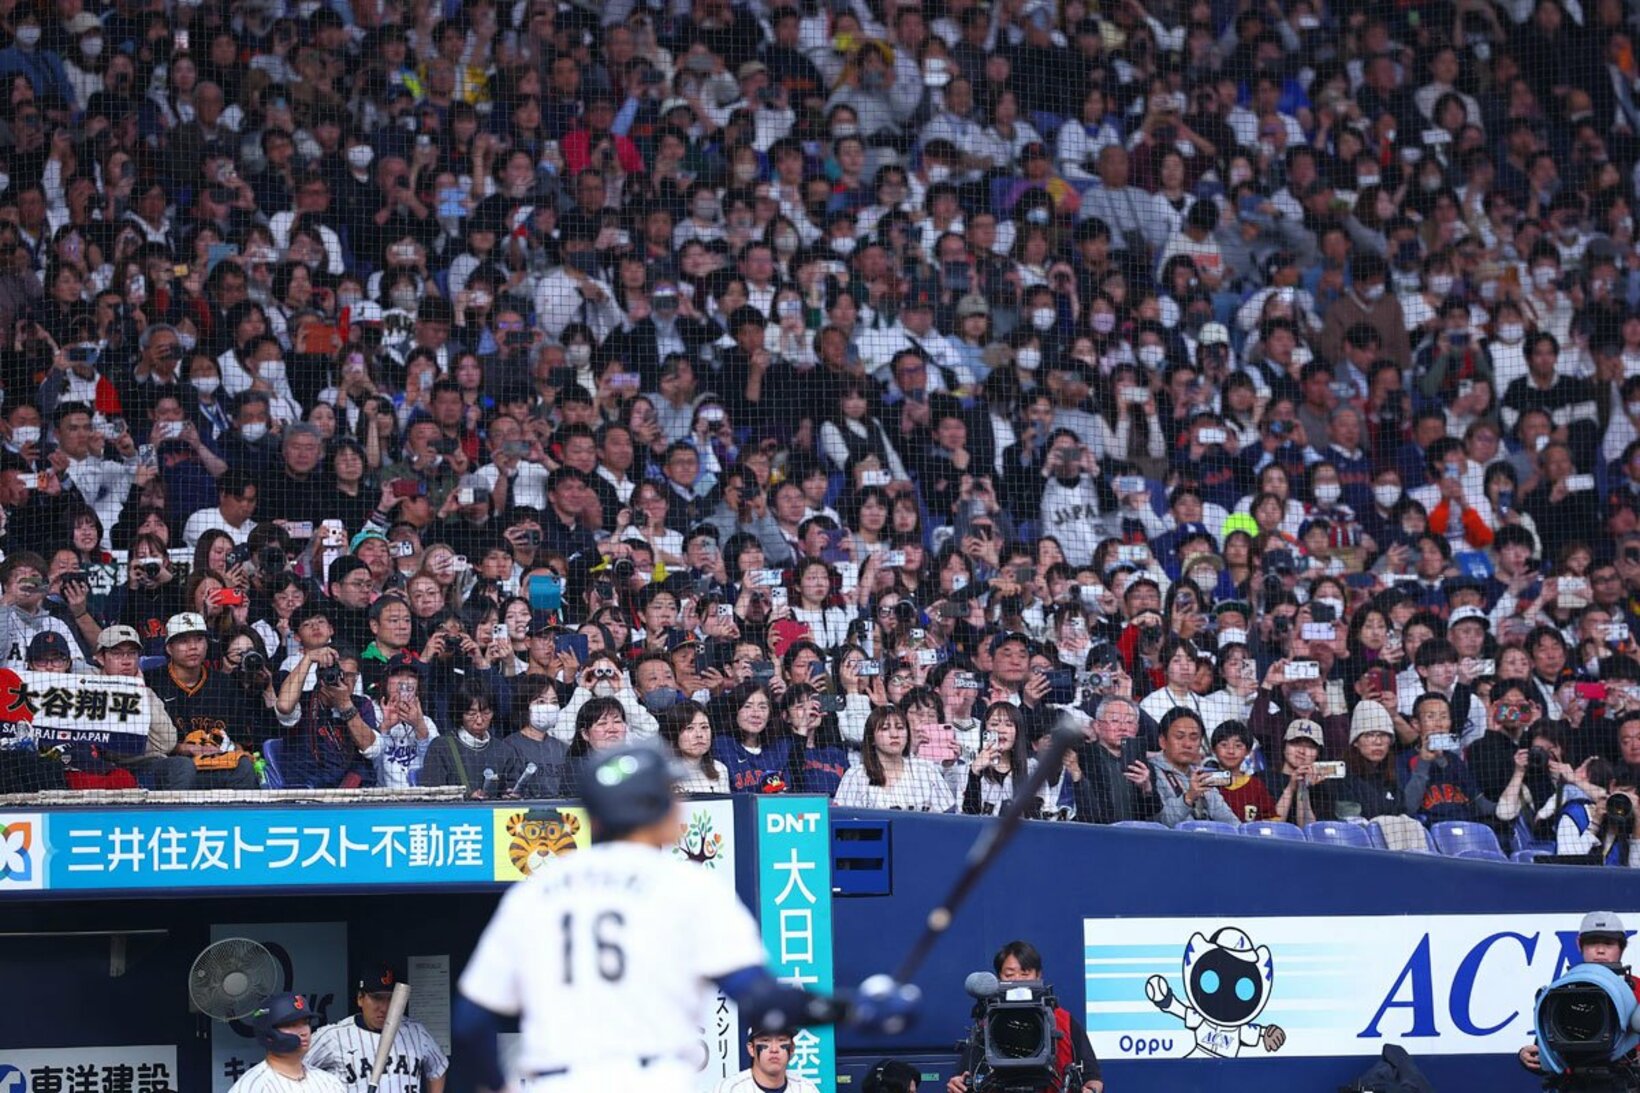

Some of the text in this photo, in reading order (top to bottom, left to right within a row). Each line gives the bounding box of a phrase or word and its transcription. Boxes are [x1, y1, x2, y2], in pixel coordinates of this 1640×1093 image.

[7, 682, 142, 722] 大谷翔平
[2, 722, 110, 743] SARAI JAPAN
[766, 813, 821, 833] DNT
[68, 823, 484, 872] 三井住友トラスト不動産
[561, 909, 626, 985] 16
[717, 989, 729, 1078] スシリー
[1119, 1035, 1173, 1055] Oppu
[30, 1063, 170, 1093] 東洋建設
